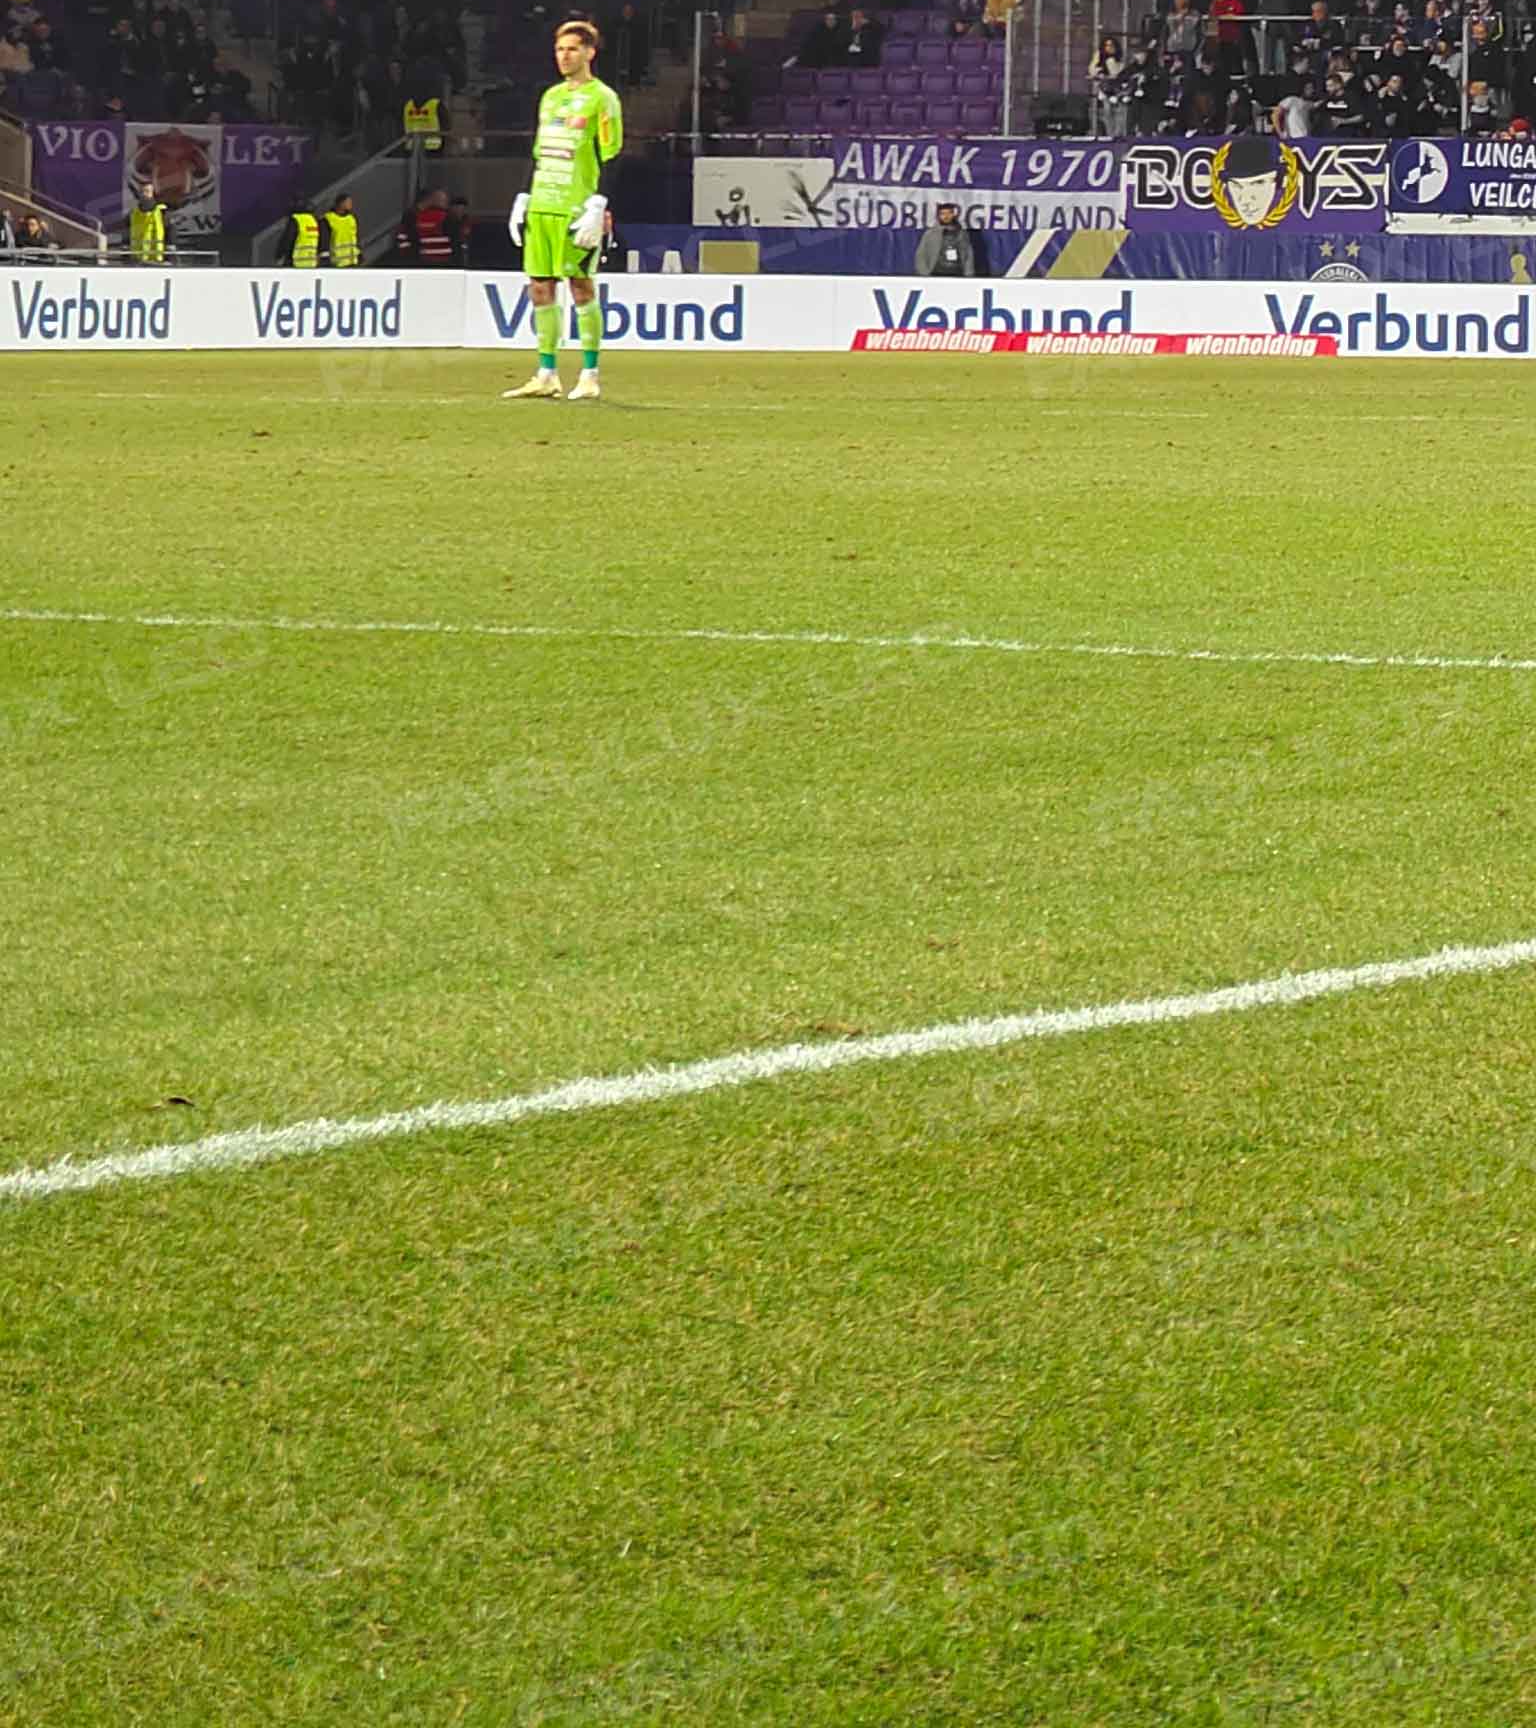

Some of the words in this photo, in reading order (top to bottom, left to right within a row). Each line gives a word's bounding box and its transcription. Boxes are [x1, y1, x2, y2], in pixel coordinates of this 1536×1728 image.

[837, 142, 981, 184] AWAK
[1000, 149, 1115, 188] 1970
[11, 278, 171, 340] Verbund
[250, 278, 402, 340] Verbund
[484, 282, 744, 342] Vbund
[872, 288, 1133, 335] Verbund
[1264, 293, 1530, 354] Verbund
